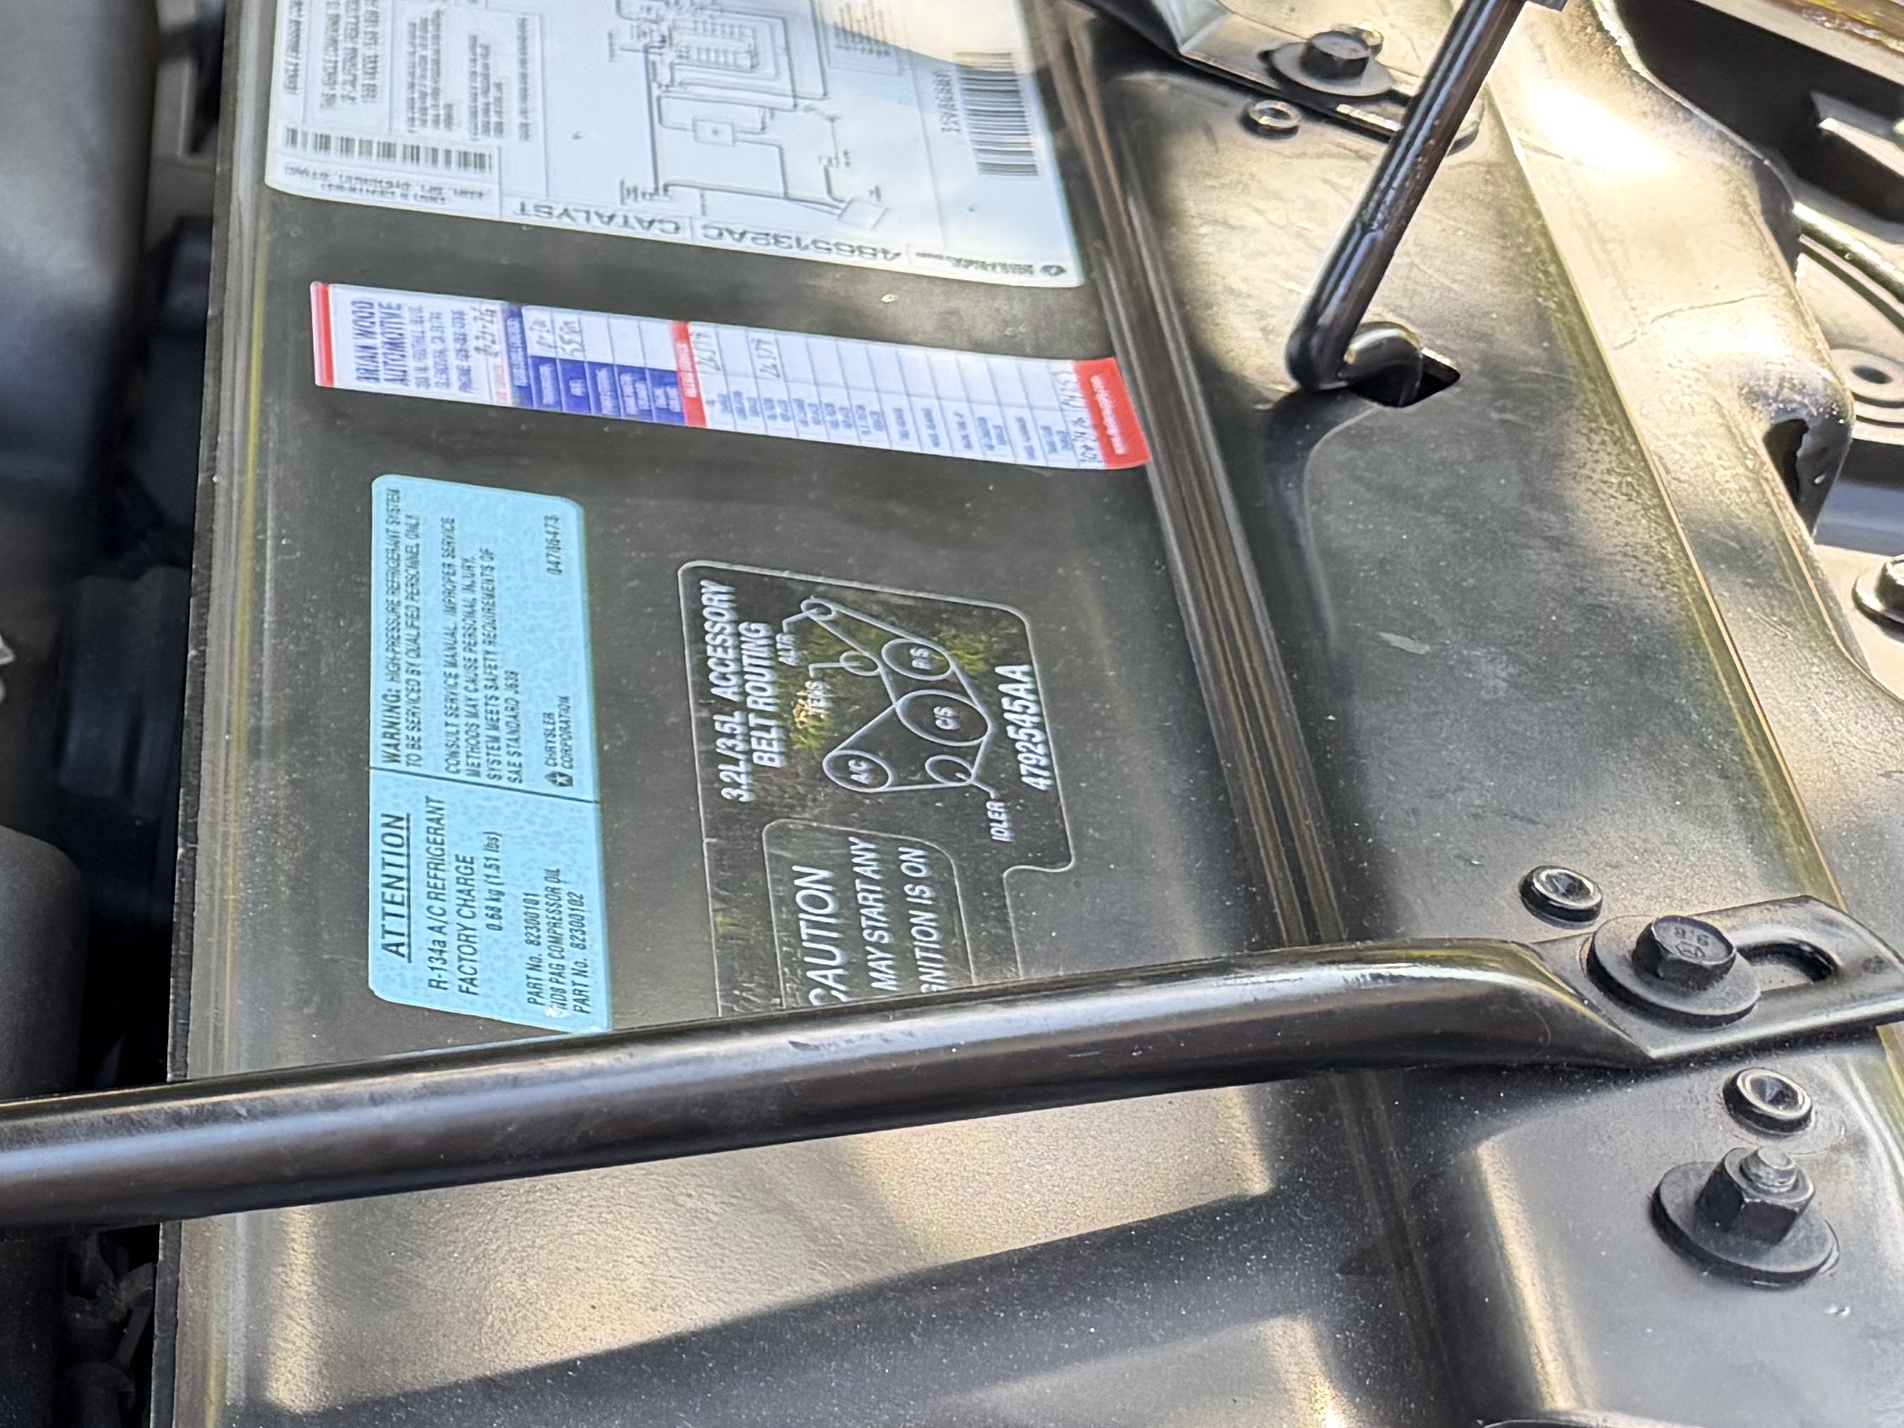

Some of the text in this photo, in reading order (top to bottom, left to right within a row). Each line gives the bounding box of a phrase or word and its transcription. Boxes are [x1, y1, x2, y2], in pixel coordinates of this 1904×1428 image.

[514, 201, 681, 236] CATALYST
[351, 300, 380, 384] BRIAN WOOD
[378, 302, 409, 386] AUTOMOTIVE
[385, 488, 400, 525] SYSTEM
[385, 528, 400, 596] REFRIGERANT
[440, 517, 456, 559] SERVICE
[404, 543, 420, 602] PERSONNEL
[404, 605, 421, 659] QUALIFIED
[462, 598, 477, 653] PERSONAL
[777, 632, 799, 666] ALTR
[405, 661, 421, 676] BY
[462, 656, 478, 693] CAUSE
[479, 548, 502, 780] SYSTEM MEETS SAFETY REQUIREMENTS OF
[701, 579, 756, 802] 3.2L/3.5L ACCESSORY
[405, 678, 421, 732] SERVICED
[443, 672, 459, 719] SERVICE
[464, 697, 479, 719] MAY
[739, 622, 787, 767] BELT ROUTING
[382, 688, 401, 763] WARNING:
[405, 735, 421, 751] BE
[444, 721, 461, 774] CONSULT
[465, 723, 481, 778] METHODS
[504, 697, 521, 757] STANDARD
[543, 712, 558, 767] CHRYSLER
[994, 665, 1053, 790] 4792545AA
[405, 753, 422, 767] TO
[506, 761, 522, 784] SAE
[483, 831, 502, 853] lbs)
[985, 802, 1013, 842] IDLER
[381, 813, 406, 958] ATTENTION
[898, 847, 928, 877] ON
[425, 796, 448, 990] R-134a A/C REFRIGERANT
[485, 890, 504, 902] kg
[485, 906, 503, 931] 0.68
[849, 836, 901, 990] MAY START ANY
[898, 884, 935, 904] IS
[455, 854, 479, 995] FACTORY CHARGE
[524, 892, 545, 1006] PART No. 82300101
[545, 887, 565, 960] COMPRESSOR
[548, 964, 566, 985] PAG
[567, 892, 590, 1014] PART No. 82300102
